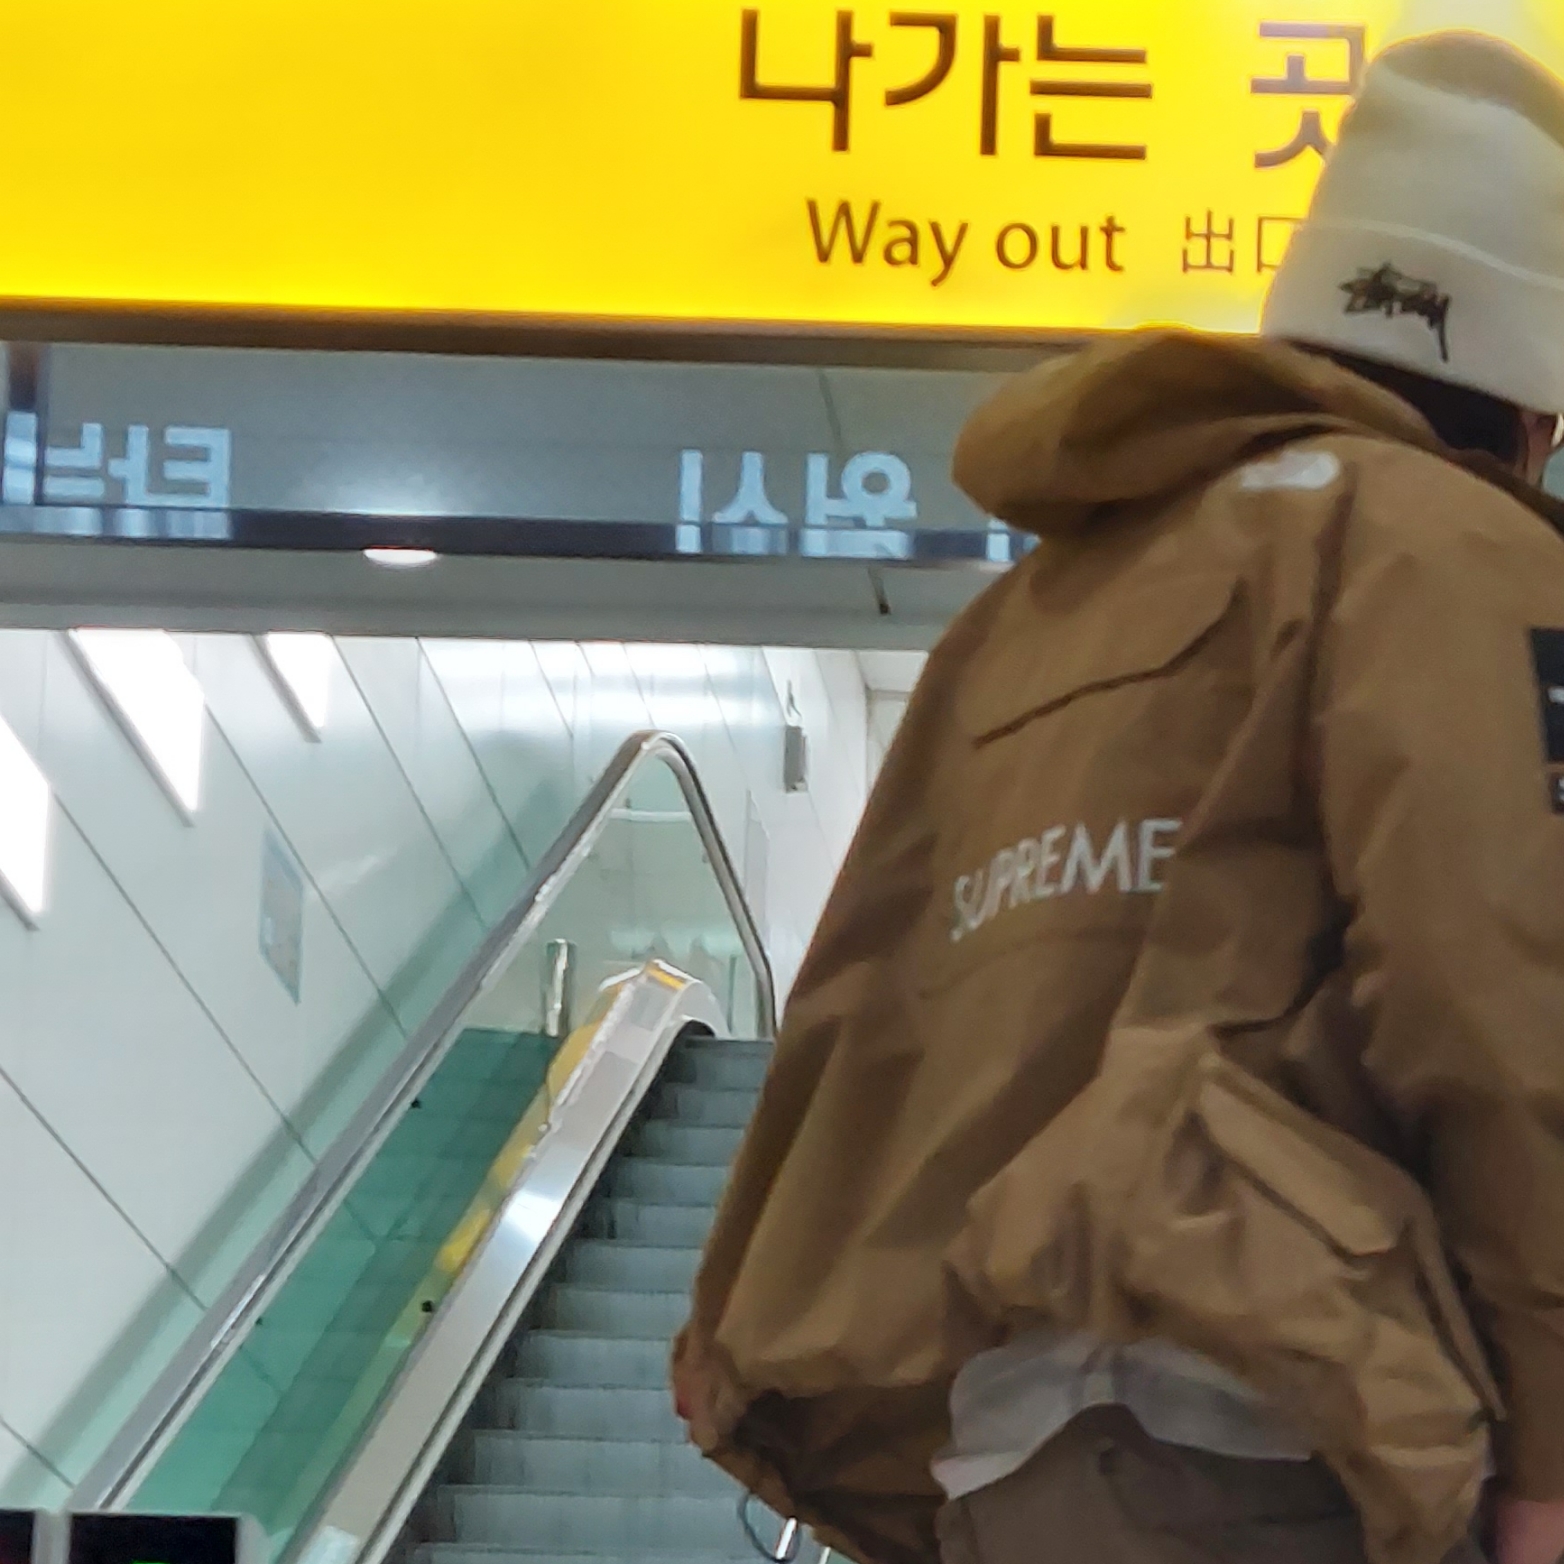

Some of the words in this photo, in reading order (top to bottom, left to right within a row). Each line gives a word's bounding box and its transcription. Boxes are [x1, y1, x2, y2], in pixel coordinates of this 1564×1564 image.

[740, 8, 1152, 160] 나가는
[1250, 21, 1366, 169] 곳
[806, 198, 969, 287] Way
[995, 214, 1126, 273] out
[951, 816, 1183, 943] SUPREME
